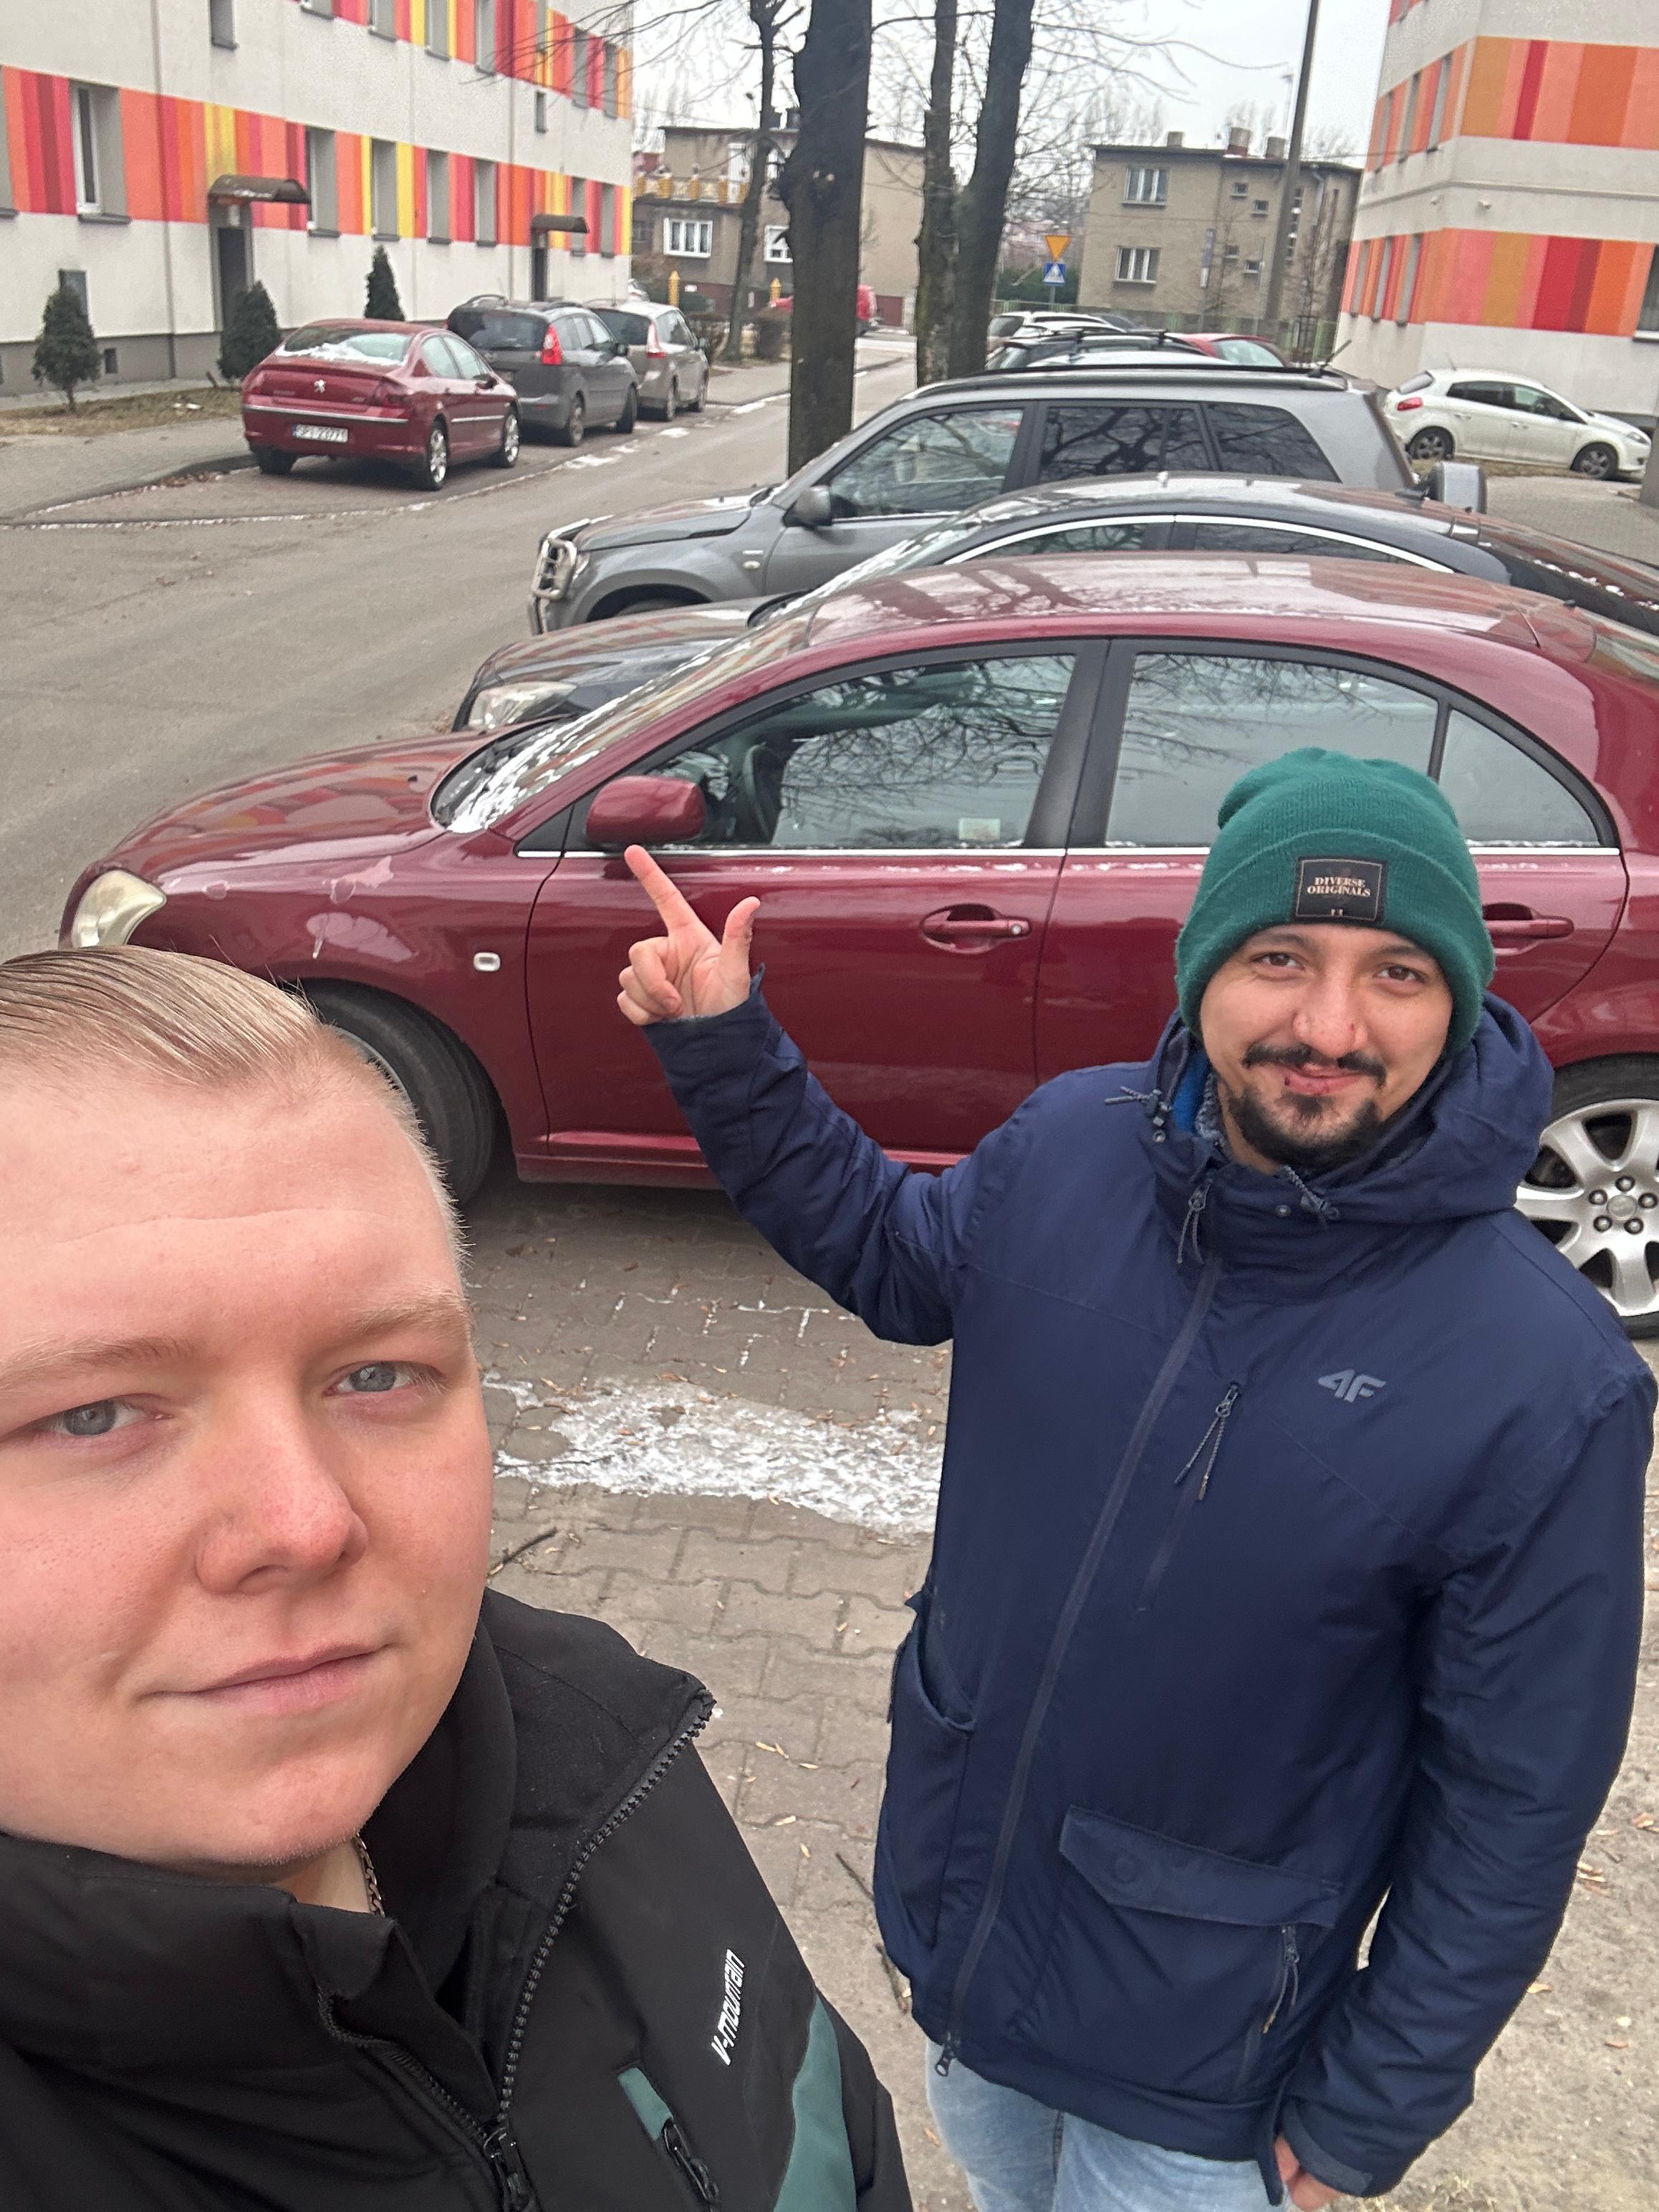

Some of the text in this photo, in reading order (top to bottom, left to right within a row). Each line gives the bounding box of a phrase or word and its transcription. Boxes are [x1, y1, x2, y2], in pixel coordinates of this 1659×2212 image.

[1314, 876, 1366, 888] DIVERSE
[1307, 885, 1371, 897] ORIGINALS
[1317, 1368, 1387, 1403] 4F
